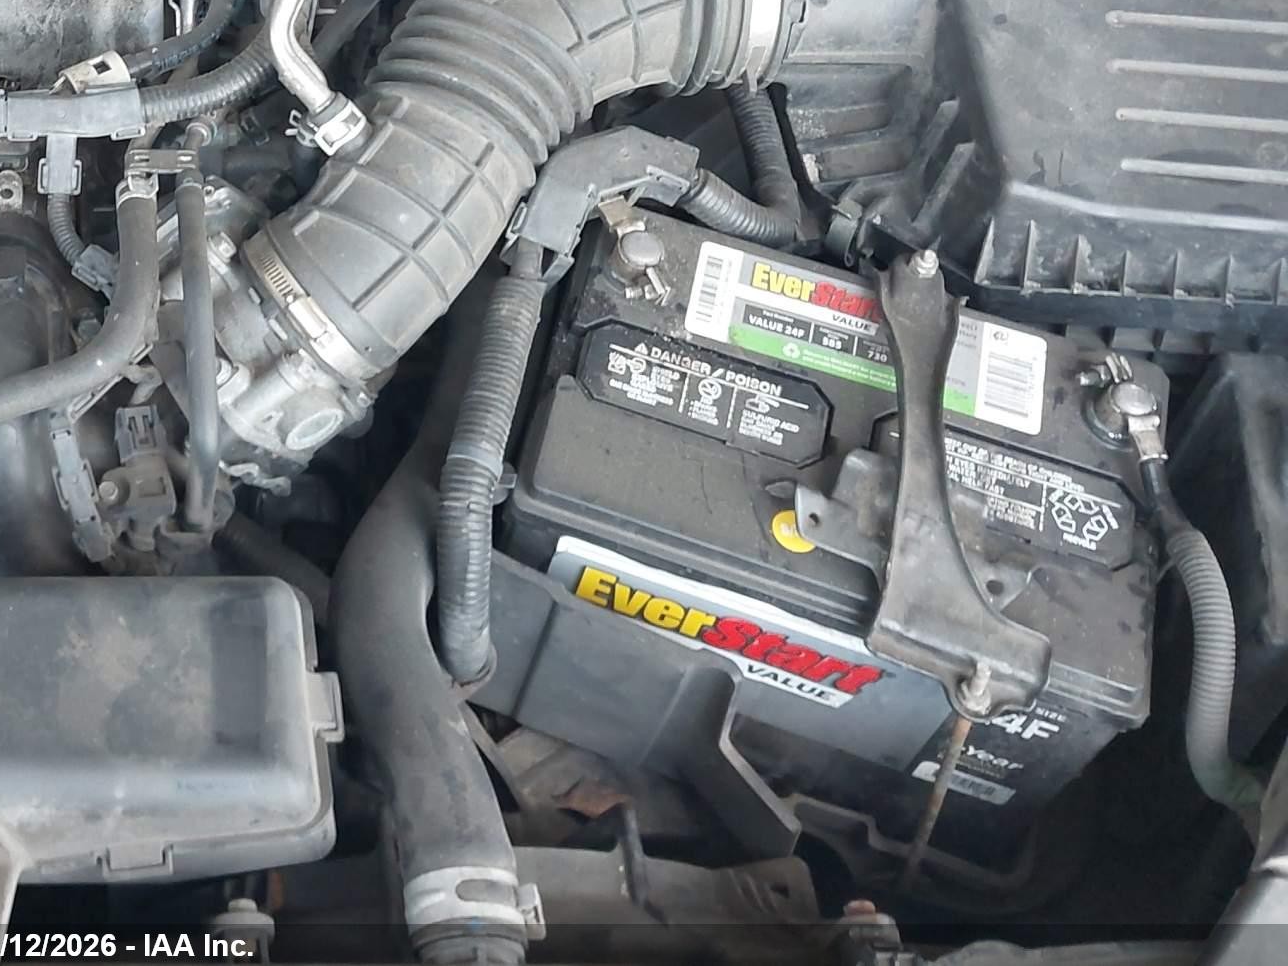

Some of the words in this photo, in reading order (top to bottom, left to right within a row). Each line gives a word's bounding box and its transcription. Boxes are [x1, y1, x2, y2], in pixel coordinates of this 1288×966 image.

[748, 314, 783, 334] VALUE
[831, 313, 873, 331] VALUE
[651, 347, 712, 378] DANGER
[725, 370, 782, 397] POISON
[575, 565, 884, 694] EverStart
[746, 663, 835, 702] VALUE
[989, 713, 1061, 739] 4F
[1034, 706, 1068, 722] SIZE
